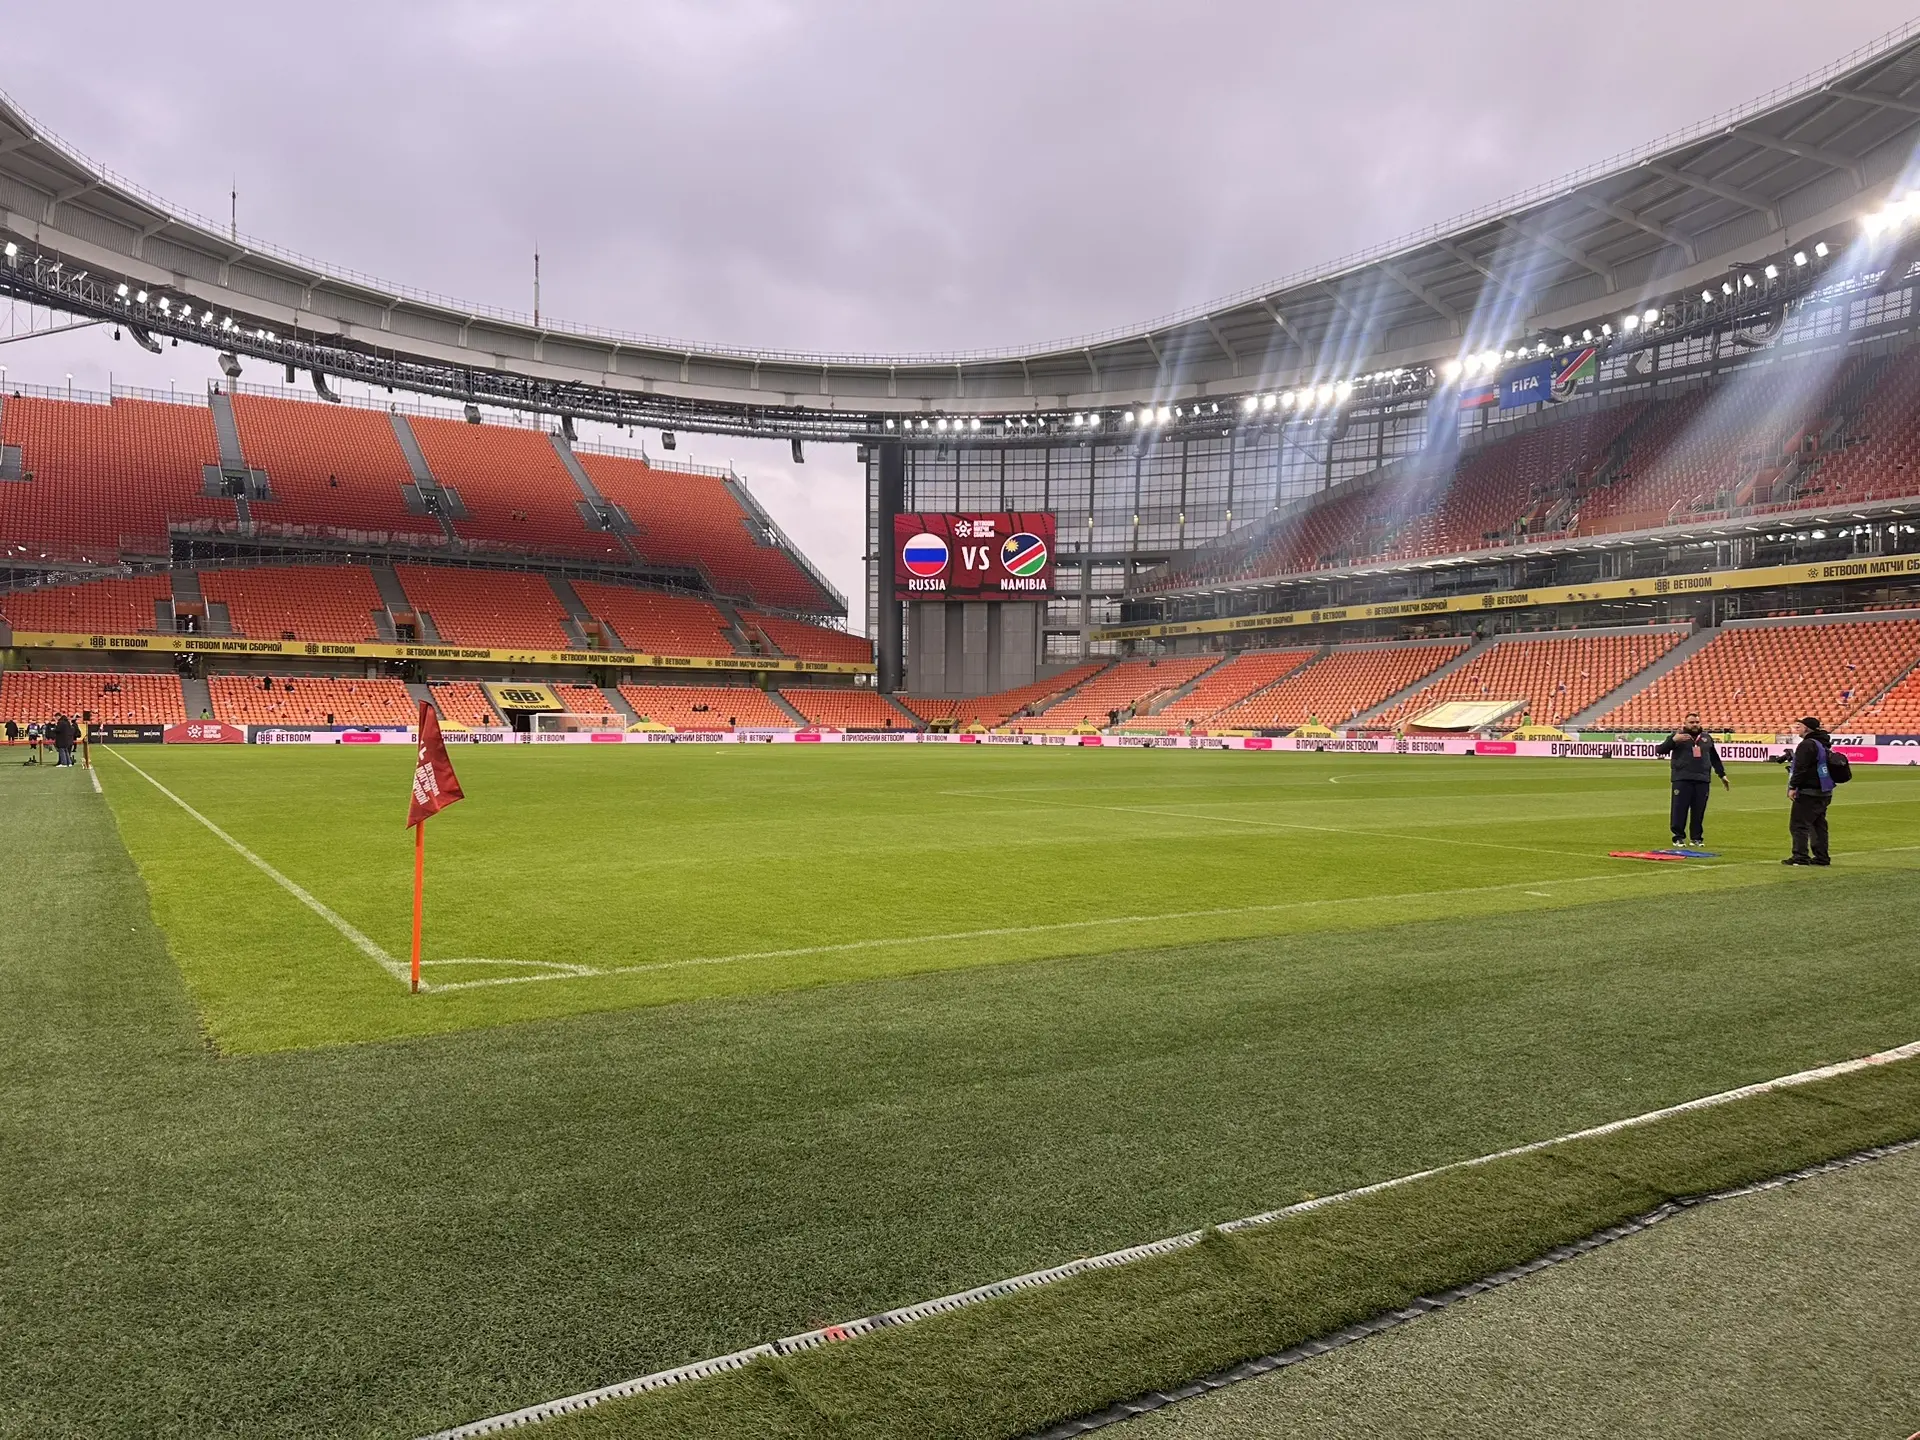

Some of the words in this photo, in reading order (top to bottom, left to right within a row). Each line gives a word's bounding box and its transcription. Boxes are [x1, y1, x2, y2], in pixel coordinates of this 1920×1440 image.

[1511, 375, 1539, 394] FIFA
[961, 546, 990, 571] VS
[1823, 563, 1867, 578] BETBOOM
[1870, 559, 1904, 574] МАТЧИ
[908, 578, 946, 591] RUSSIA
[1000, 578, 1047, 590] NAMIBIA
[1673, 576, 1712, 590] BETBOOM
[1497, 594, 1528, 605] BETBOOM
[1374, 605, 1400, 615] BETBOOM
[1421, 599, 1448, 611] СБОРНОЙ
[110, 638, 148, 648] BETBOOM
[185, 640, 221, 650] BETBOOM
[222, 642, 247, 651] МАТЧИ
[249, 642, 282, 652] СБОРНОЙ
[322, 645, 355, 654] BETBOOM
[406, 647, 437, 657] BETBOOM
[438, 649, 460, 658] МАТЧИ
[461, 649, 491, 659] СБОРНОЙ
[276, 733, 311, 742] BETBOOM
[469, 733, 503, 743] BETBOOM
[695, 734, 723, 742] BETBOOM
[1301, 740, 1345, 750] ПРИЛОЖЕНИИ
[1346, 740, 1379, 750] BETBOOM
[1412, 742, 1445, 752] BETBOOM
[1551, 743, 1557, 754] В
[1558, 743, 1622, 756] ПРИЛОЖЕНИИ
[1721, 746, 1768, 759] BETBOOM
